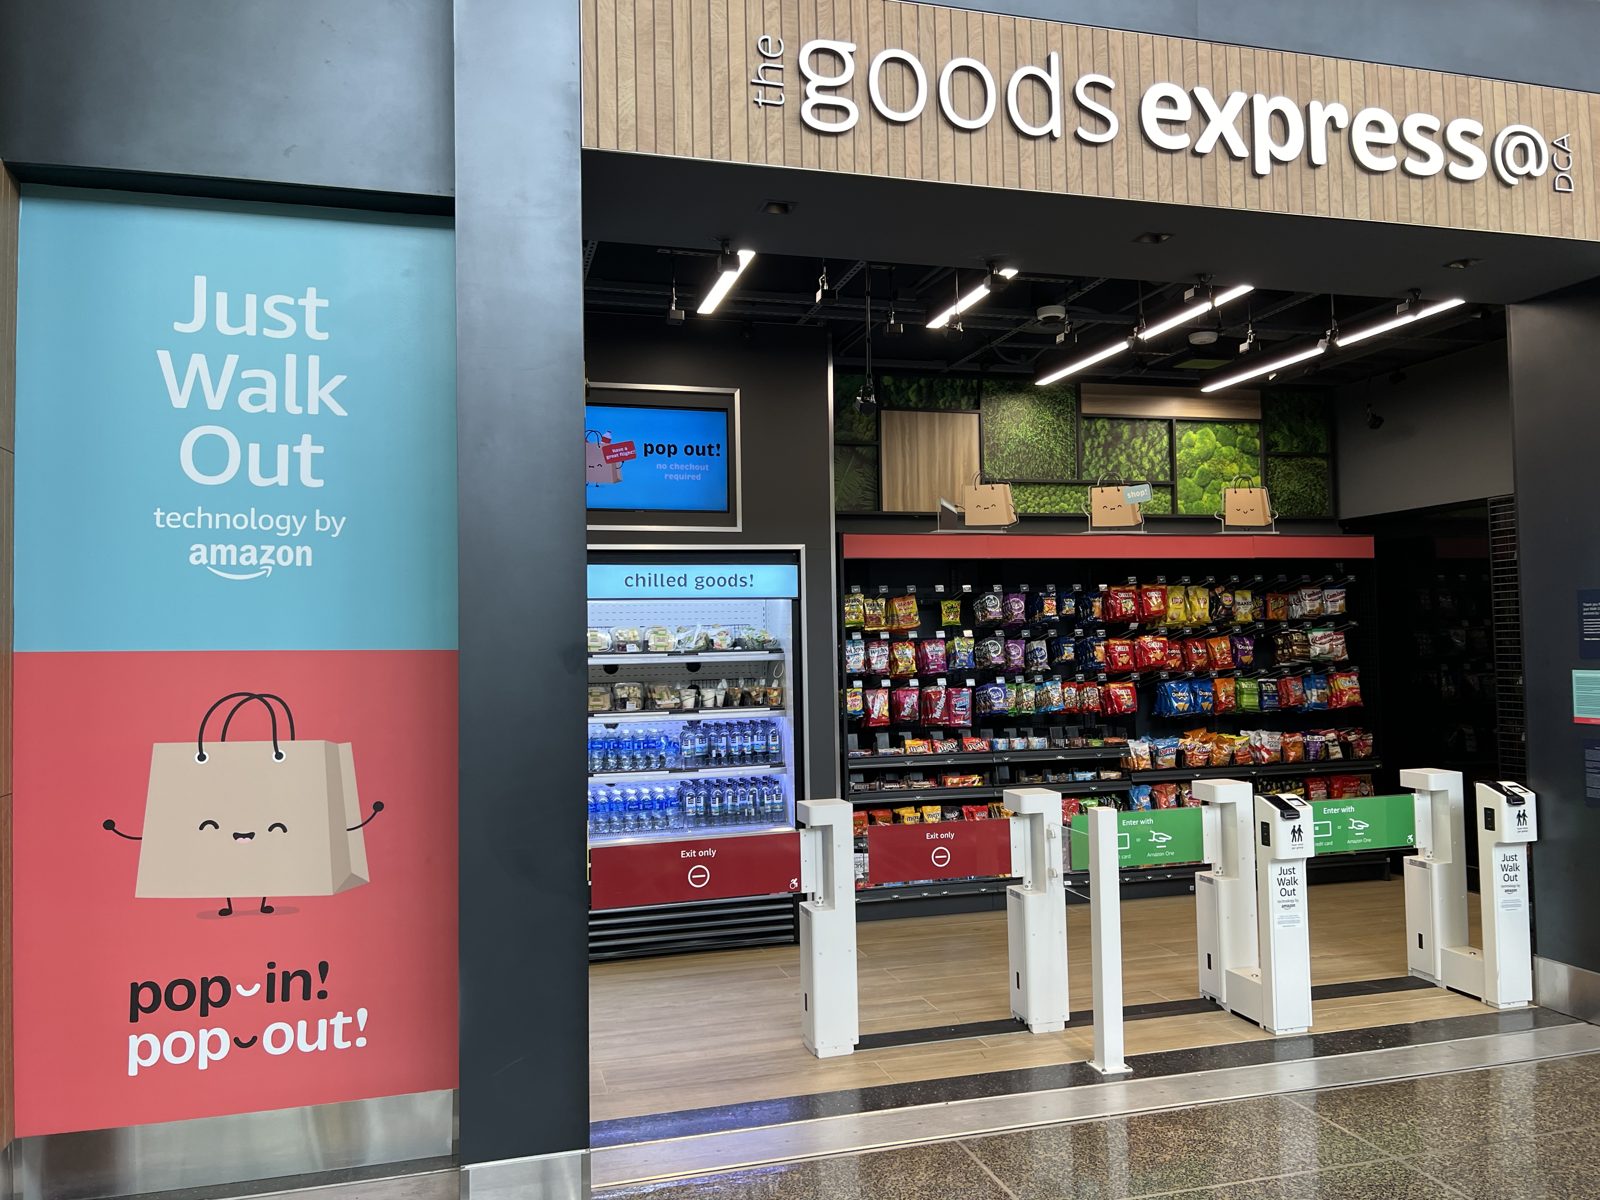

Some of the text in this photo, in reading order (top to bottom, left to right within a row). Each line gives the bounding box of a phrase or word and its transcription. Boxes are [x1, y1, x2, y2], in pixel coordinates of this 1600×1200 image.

[751, 34, 785, 108] the
[799, 38, 1119, 144] goods
[1552, 132, 1575, 193] DCA
[173, 275, 329, 341] Just
[156, 350, 348, 416] Walk
[643, 442, 721, 457] pop out!
[179, 425, 325, 488] Out
[664, 473, 702, 481] required
[1127, 489, 1148, 499] shop!
[153, 506, 346, 537] technology by
[189, 543, 313, 567] amazon
[624, 573, 754, 591] chilled goods!
[1341, 805, 1355, 813] with
[926, 832, 955, 841] Exit only
[680, 848, 716, 858] Exit only
[1502, 853, 1518, 862] Just
[1278, 867, 1296, 876] Just
[1500, 863, 1520, 872] Walk
[1277, 877, 1299, 887] Walk
[1503, 874, 1518, 882] Out
[1279, 888, 1297, 897] Out
[128, 961, 330, 1023] pop in!
[127, 1008, 369, 1076] pop out!
